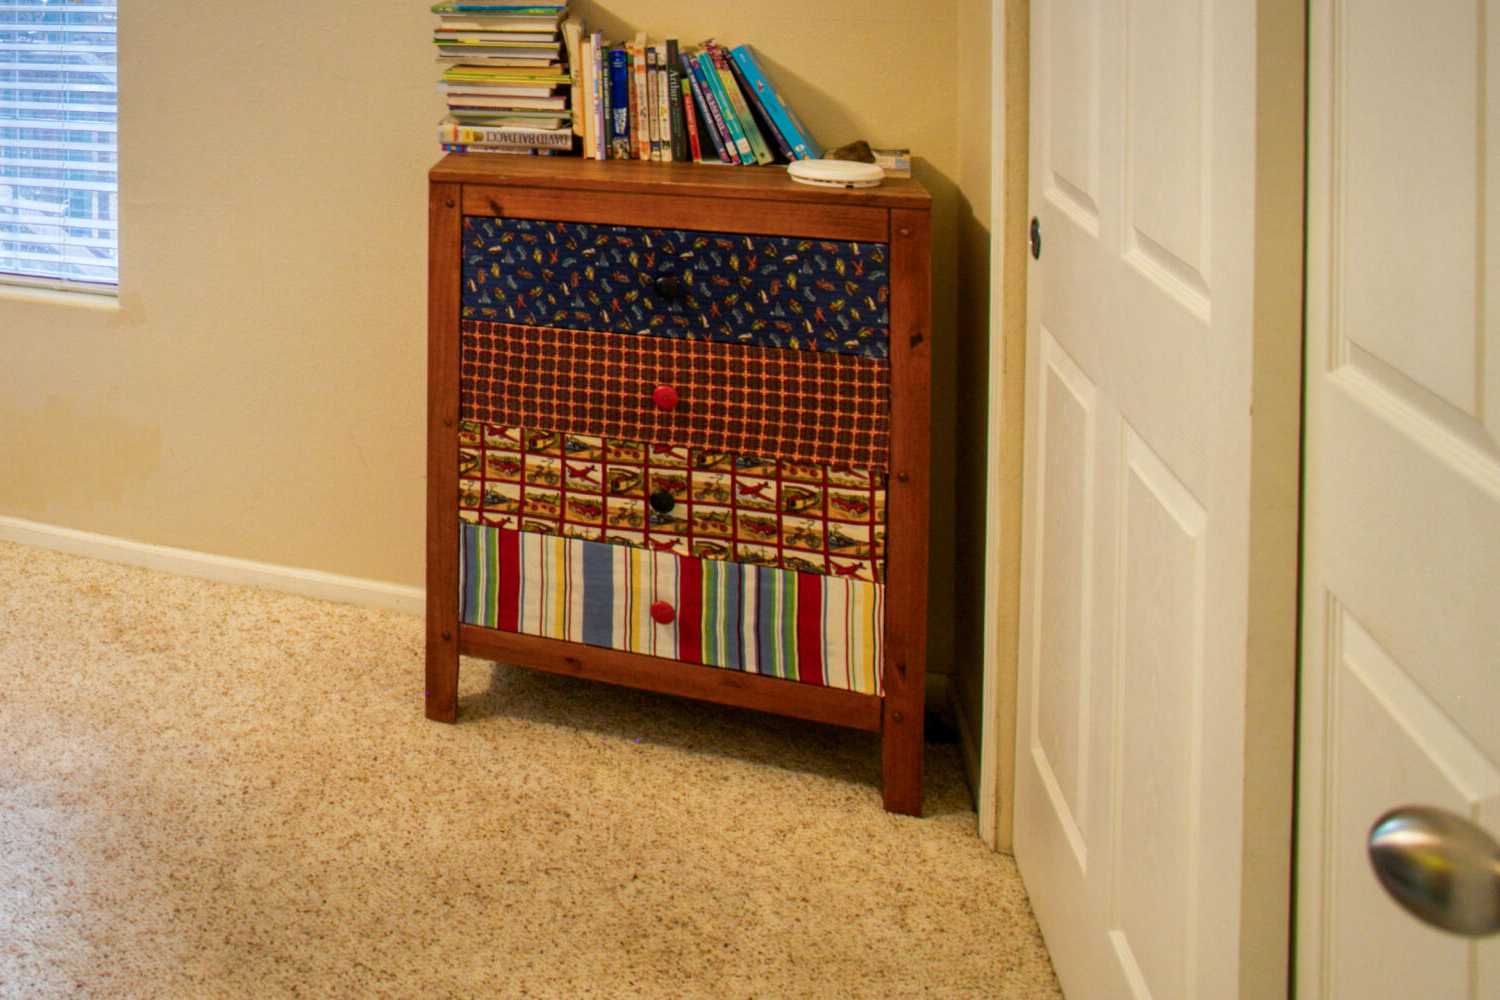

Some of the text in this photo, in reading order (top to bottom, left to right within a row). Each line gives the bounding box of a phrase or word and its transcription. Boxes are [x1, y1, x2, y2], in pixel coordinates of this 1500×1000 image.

[669, 69, 680, 102] Arthur
[486, 131, 568, 145] DAVID BALDACCI
